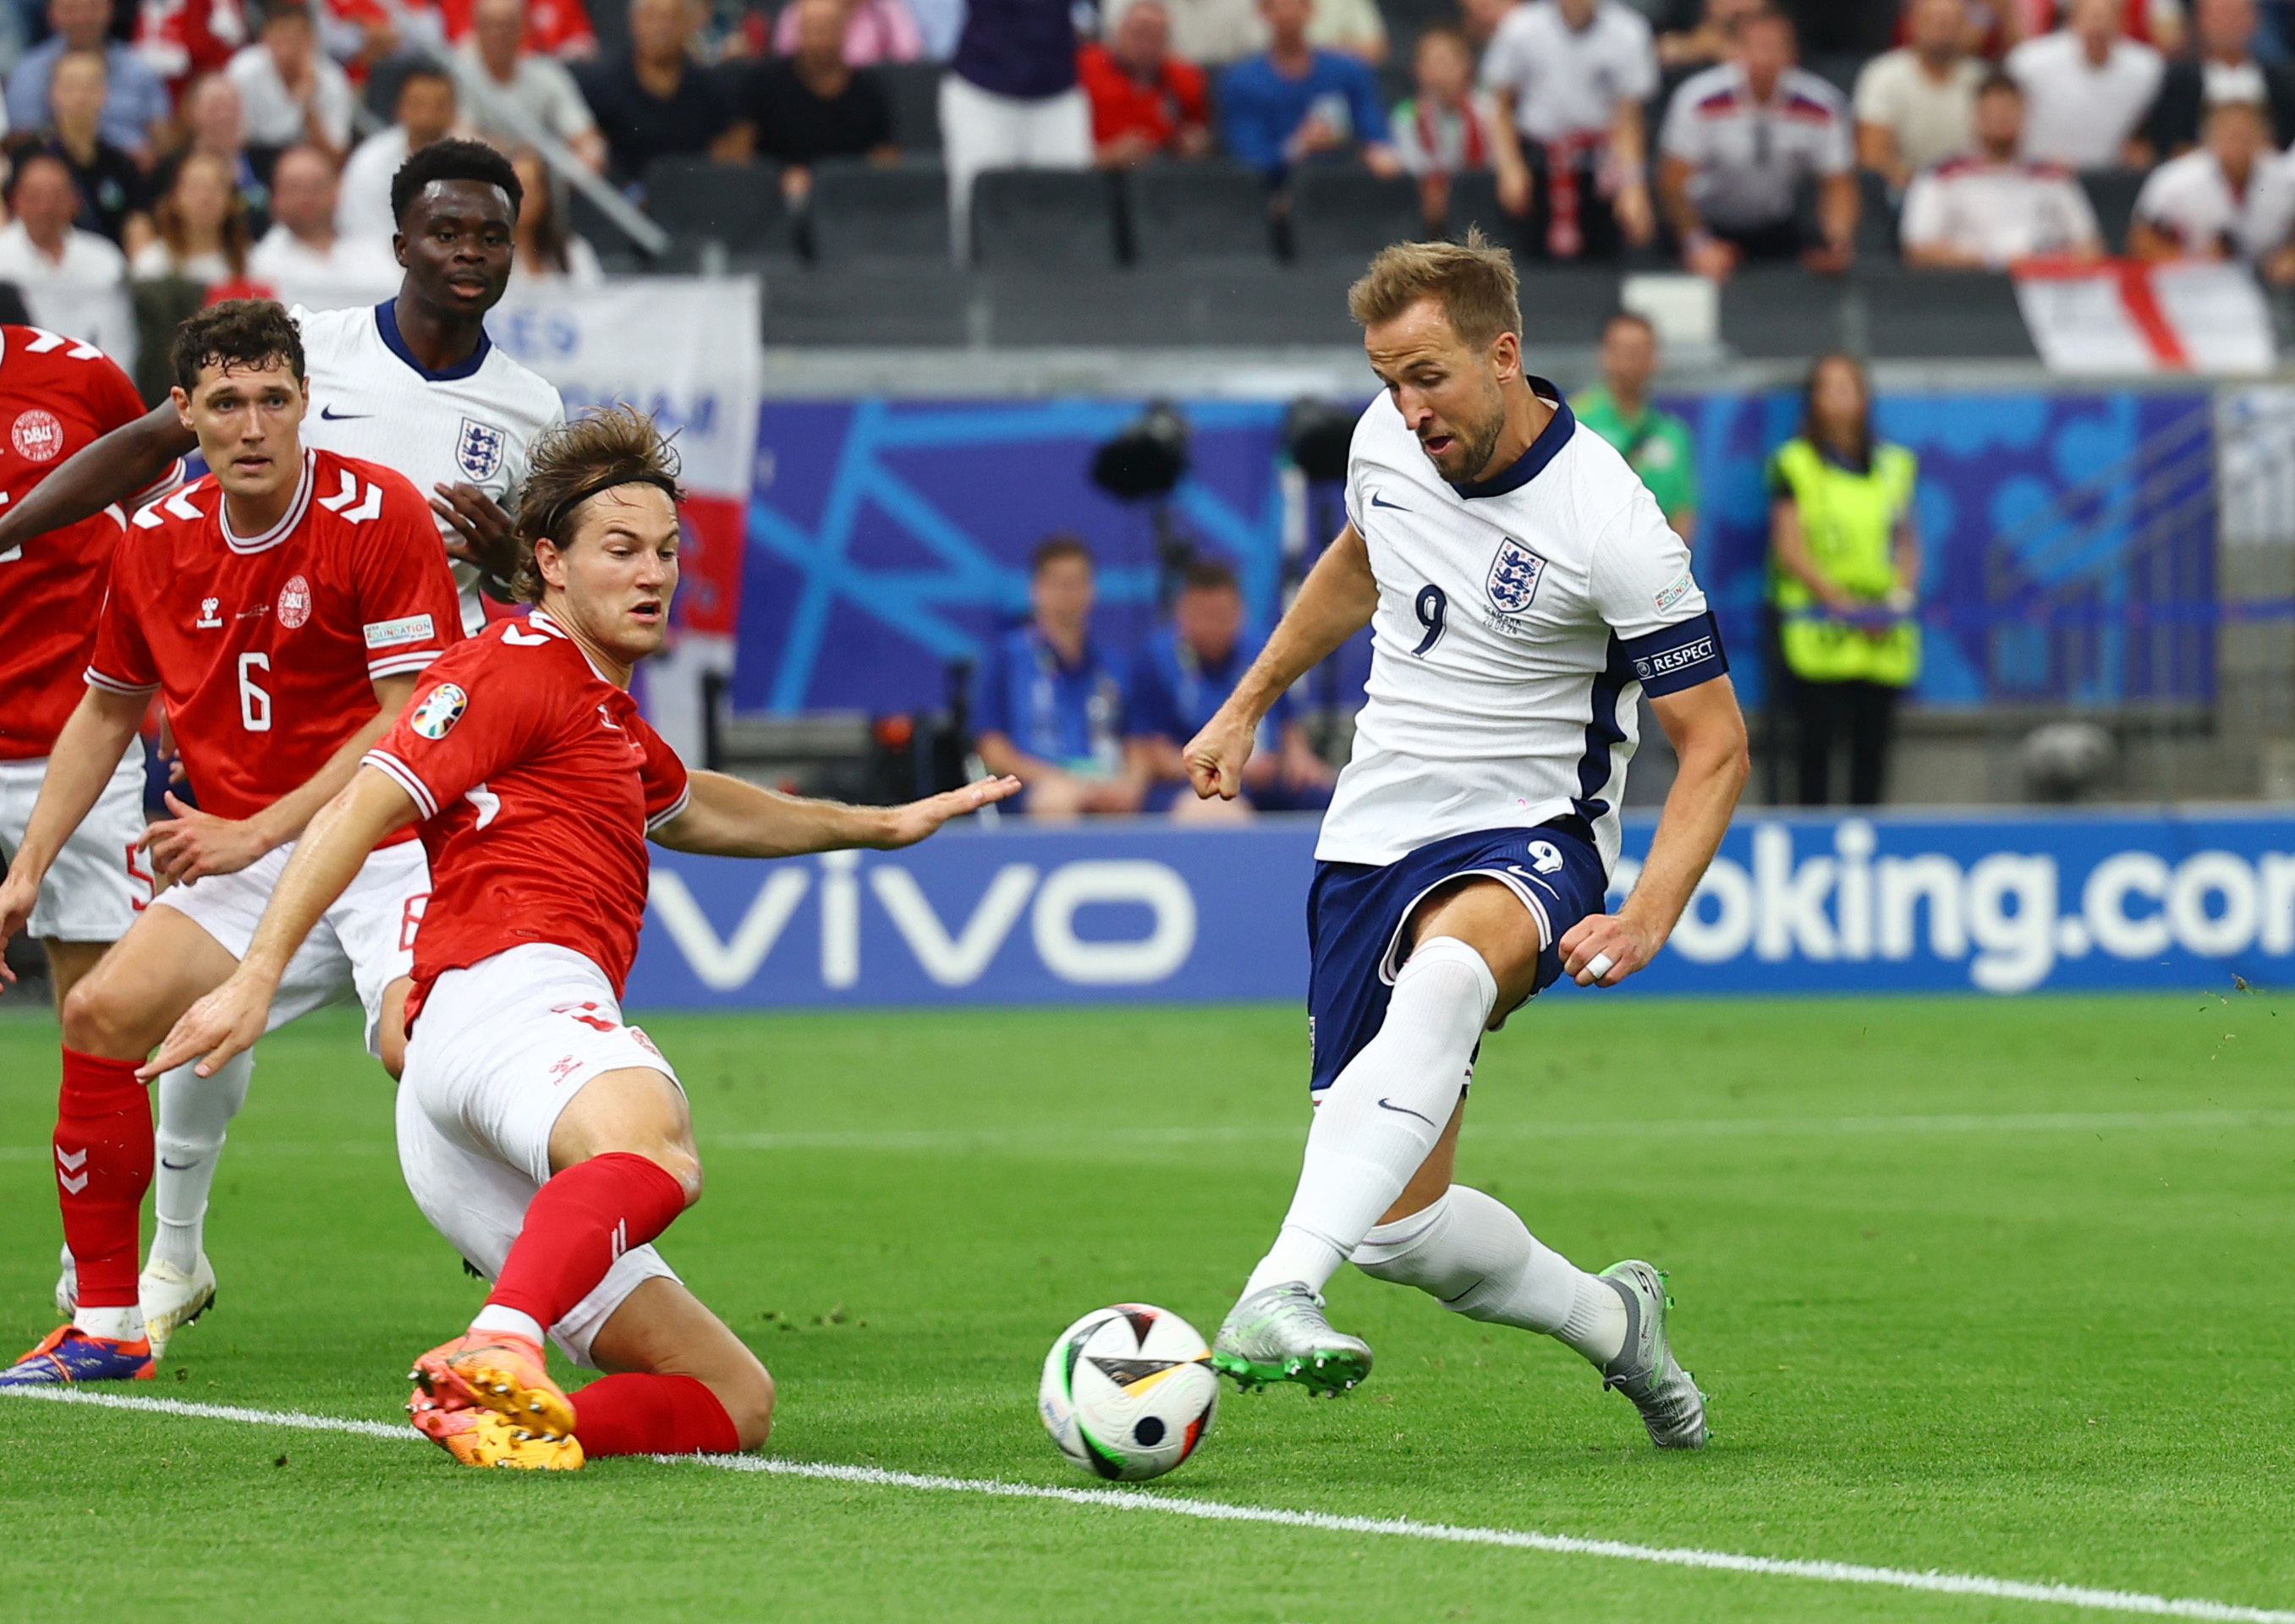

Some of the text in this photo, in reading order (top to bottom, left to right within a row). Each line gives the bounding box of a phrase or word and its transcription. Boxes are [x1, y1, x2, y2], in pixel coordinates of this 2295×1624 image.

[22, 425, 53, 444] DBU
[1411, 584, 1447, 660] 9
[1653, 640, 1713, 672] RESPECT
[239, 652, 272, 732] 6
[125, 842, 156, 911] 5
[1528, 840, 1563, 875] 9
[649, 848, 1195, 990] vivo
[1606, 819, 2295, 994] oking.co
